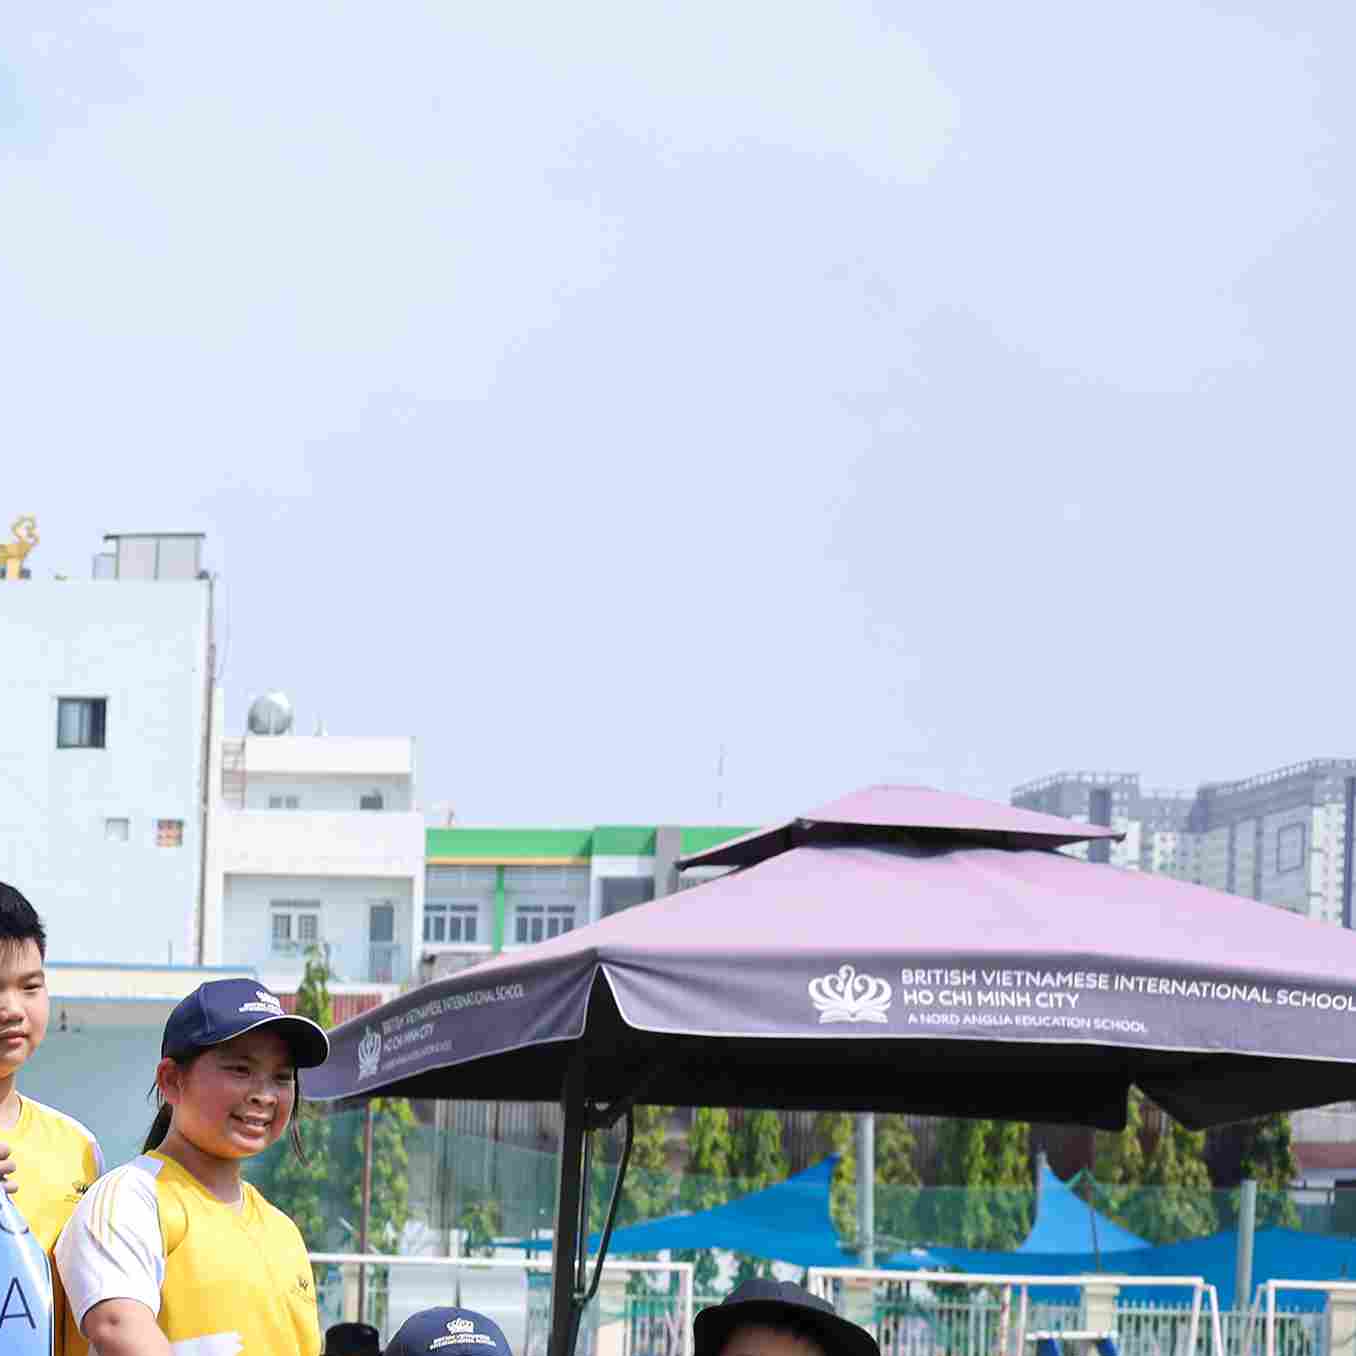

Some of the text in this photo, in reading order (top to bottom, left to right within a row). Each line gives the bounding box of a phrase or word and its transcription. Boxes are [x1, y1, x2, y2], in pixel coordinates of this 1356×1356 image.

[901, 968, 1356, 1012] BRITISH VIETNAMESE INTERNATIONAL SCHOOL
[903, 989, 1080, 1009] HO CHI MINH CITY
[907, 1013, 1148, 1033] A NORD ANGLIA EDUCATION SCHOOL
